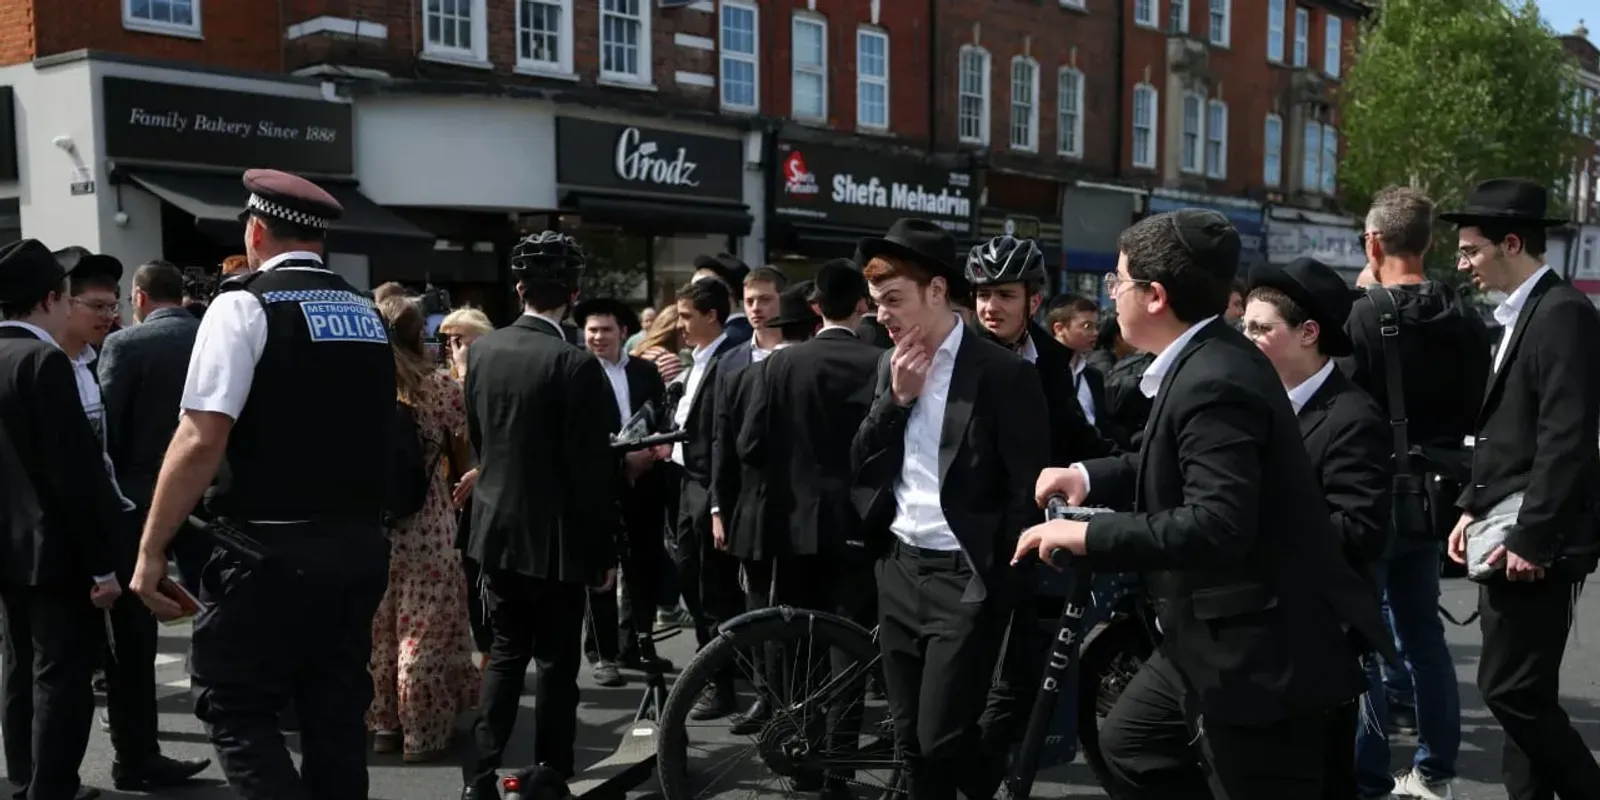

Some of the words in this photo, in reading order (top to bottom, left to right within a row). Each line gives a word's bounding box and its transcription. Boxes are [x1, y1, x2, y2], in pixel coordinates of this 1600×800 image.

[130, 108, 188, 132] Family
[194, 115, 252, 138] Bakery
[257, 120, 299, 139] Since
[306, 127, 337, 143] 1888
[615, 126, 701, 187] Grodz
[831, 172, 888, 208] Shefa
[891, 182, 971, 217] Mehadrin
[312, 314, 384, 339] POLICE
[1043, 603, 1084, 692] PURE
